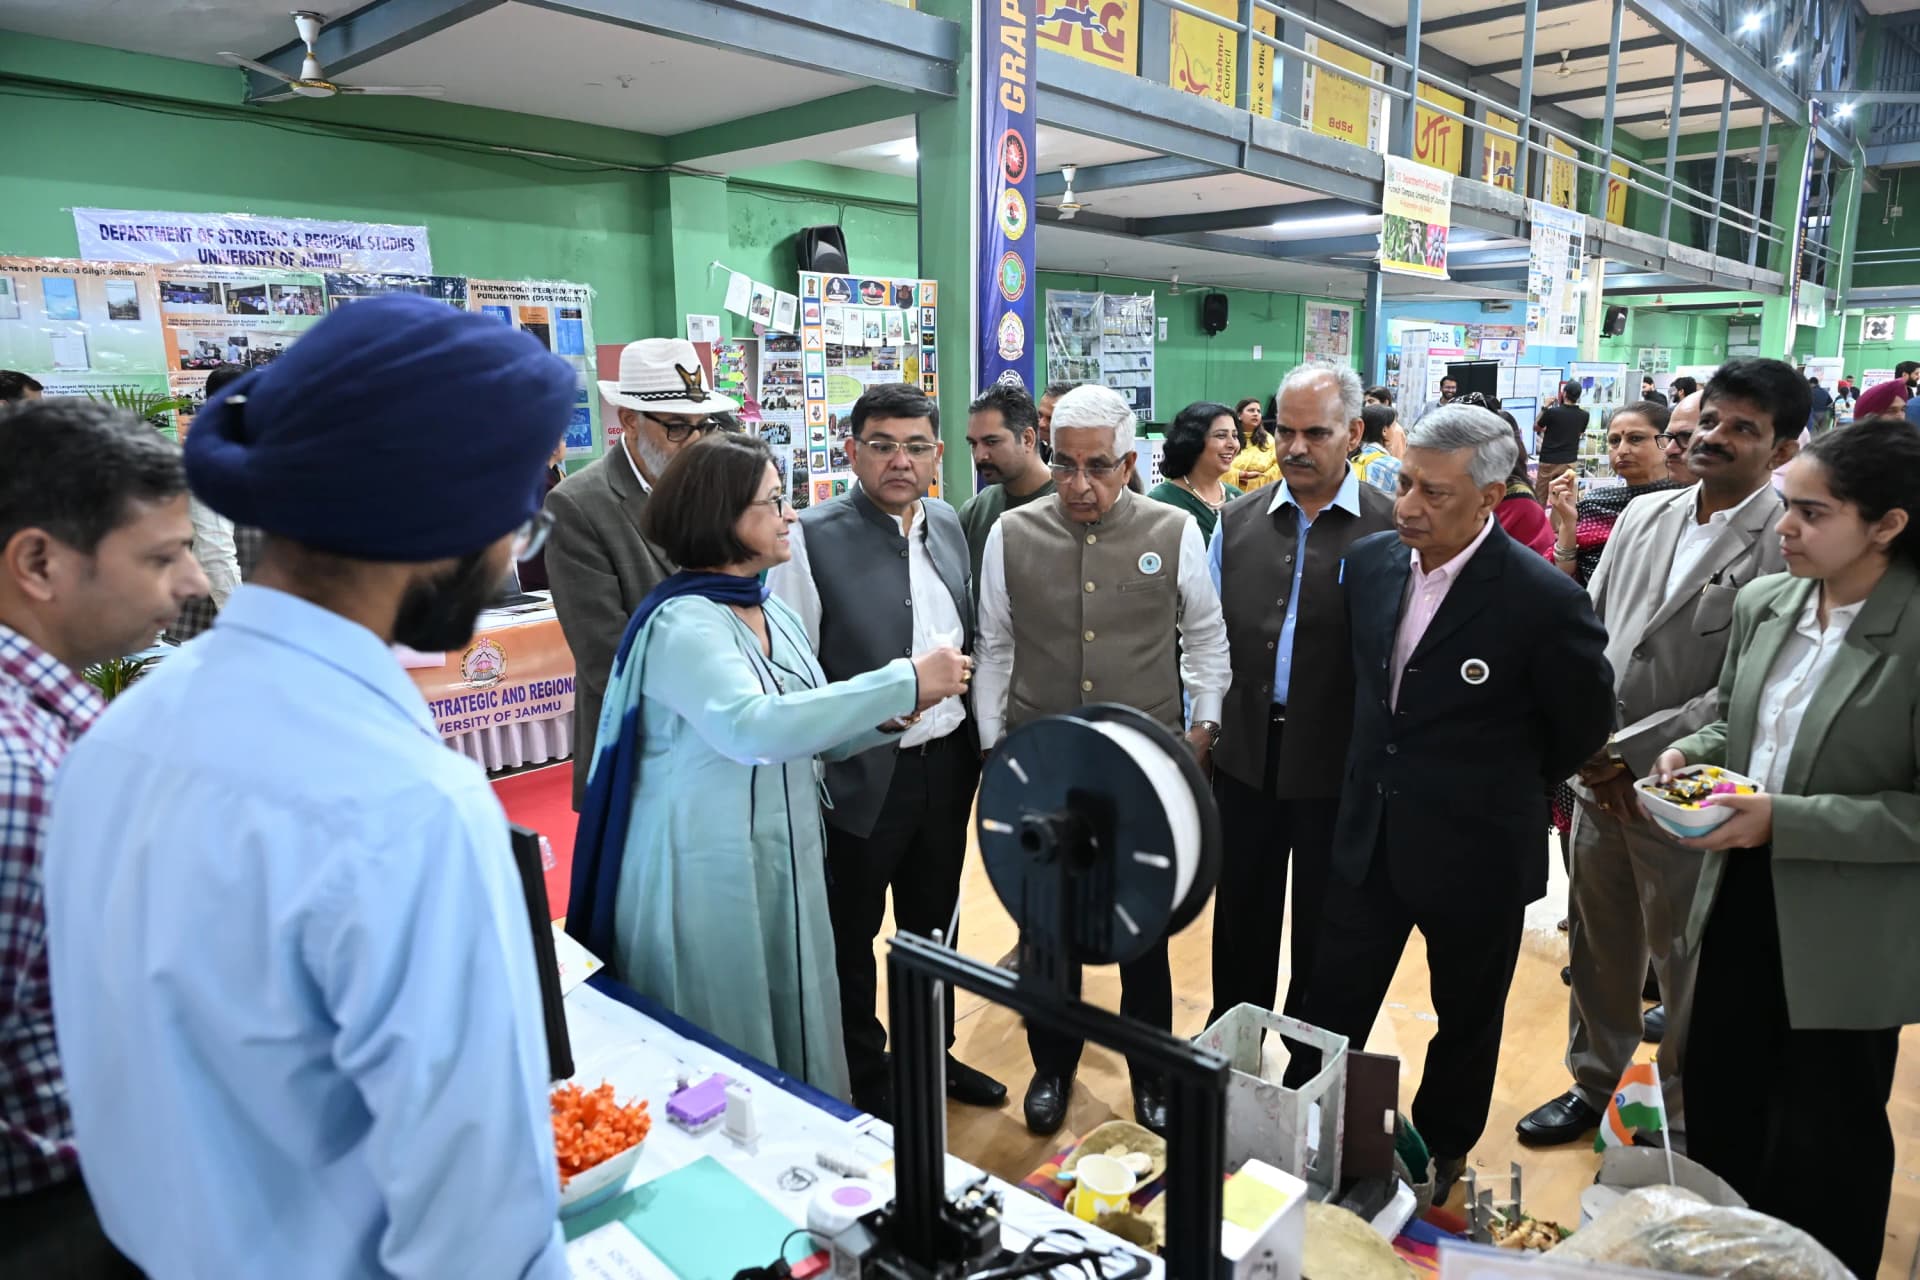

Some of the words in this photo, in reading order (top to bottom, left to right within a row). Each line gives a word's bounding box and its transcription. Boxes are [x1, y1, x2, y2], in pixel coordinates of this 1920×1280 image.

[1215, 32, 1224, 92] Kashmir
[1223, 49, 1232, 99] Council
[99, 223, 193, 243] DEPARTMENT
[197, 227, 214, 244] OF
[217, 229, 288, 247] STRATEGIC
[292, 232, 302, 247] &
[304, 233, 365, 250] REGIONAL
[367, 235, 416, 252] STUDIES
[197, 248, 275, 266] UNIVERSITY
[279, 251, 296, 266] OF
[429, 691, 498, 718] STRATEGIC
[502, 685, 526, 707] AND
[493, 710, 512, 723] OF
[514, 700, 561, 719] JAMMU
